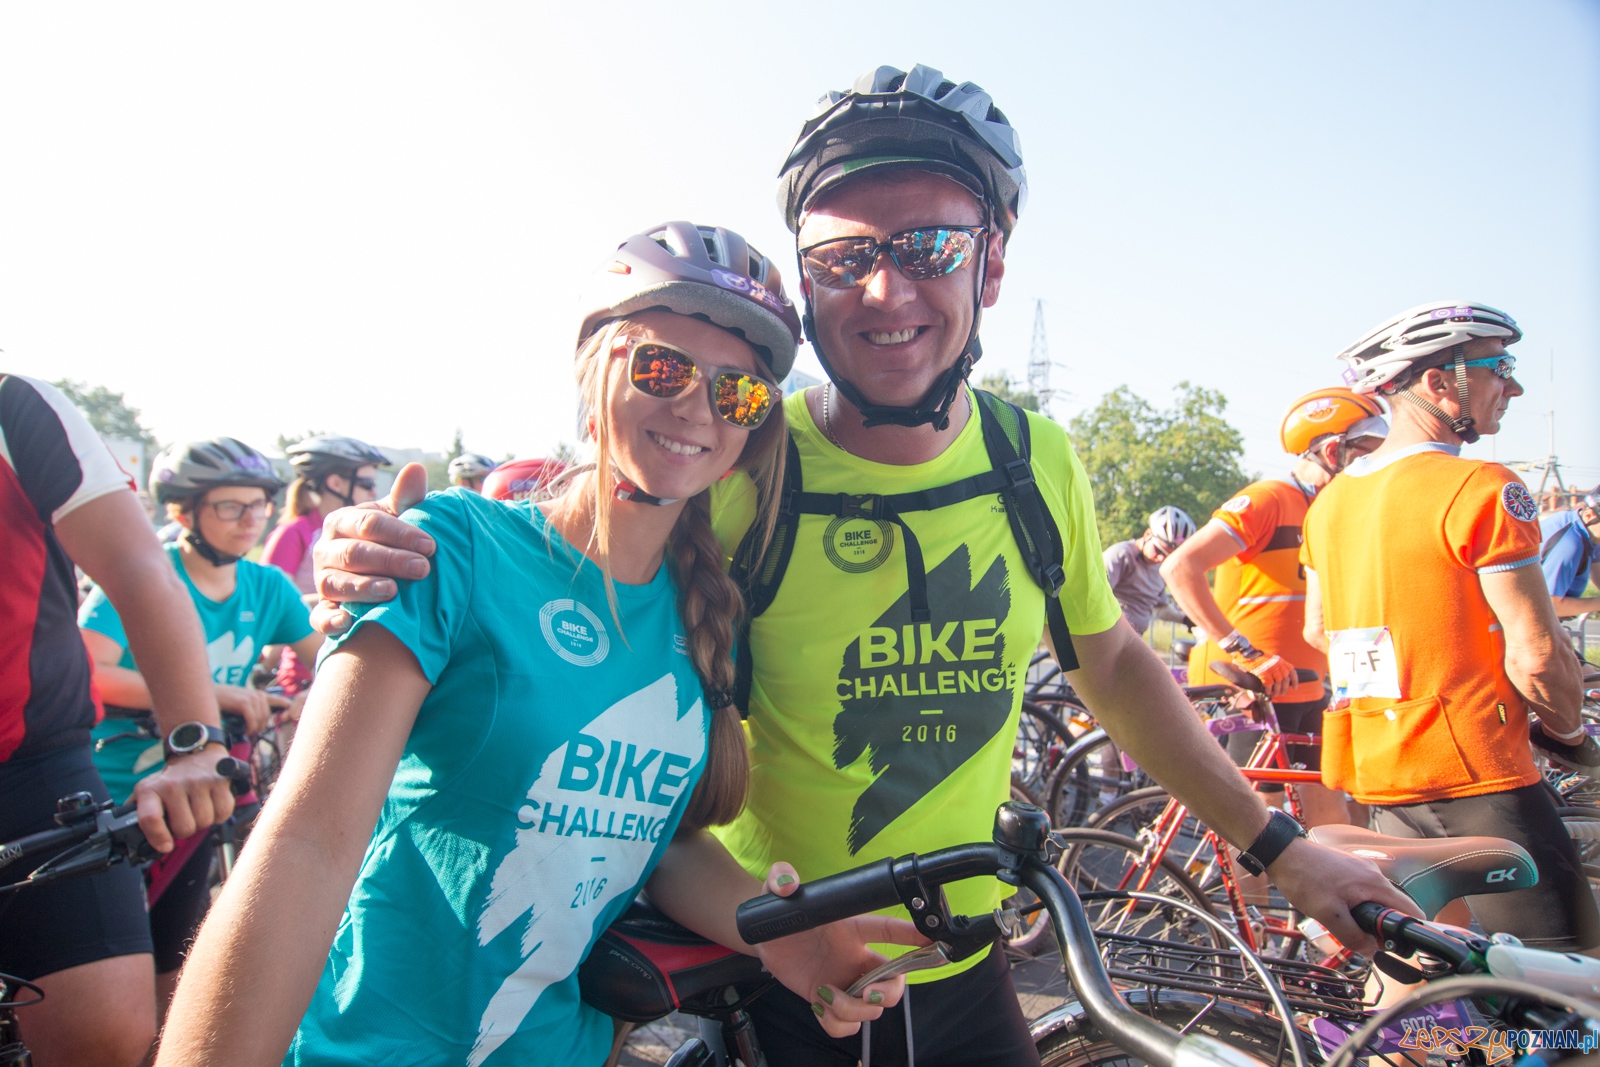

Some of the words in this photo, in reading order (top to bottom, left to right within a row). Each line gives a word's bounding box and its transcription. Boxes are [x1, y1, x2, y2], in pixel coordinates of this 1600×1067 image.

[840, 539, 877, 547] CHALLENGE
[844, 530, 871, 541] BIKE
[557, 627, 593, 642] CHALLENGE
[562, 620, 587, 636] BIKE
[859, 618, 996, 669] BIKE
[836, 667, 1016, 700] CHALLENGE
[902, 725, 957, 743] 2016
[557, 732, 692, 807] BIKE
[515, 798, 667, 843] CHALLENG
[1400, 1014, 1438, 1033] 6073
